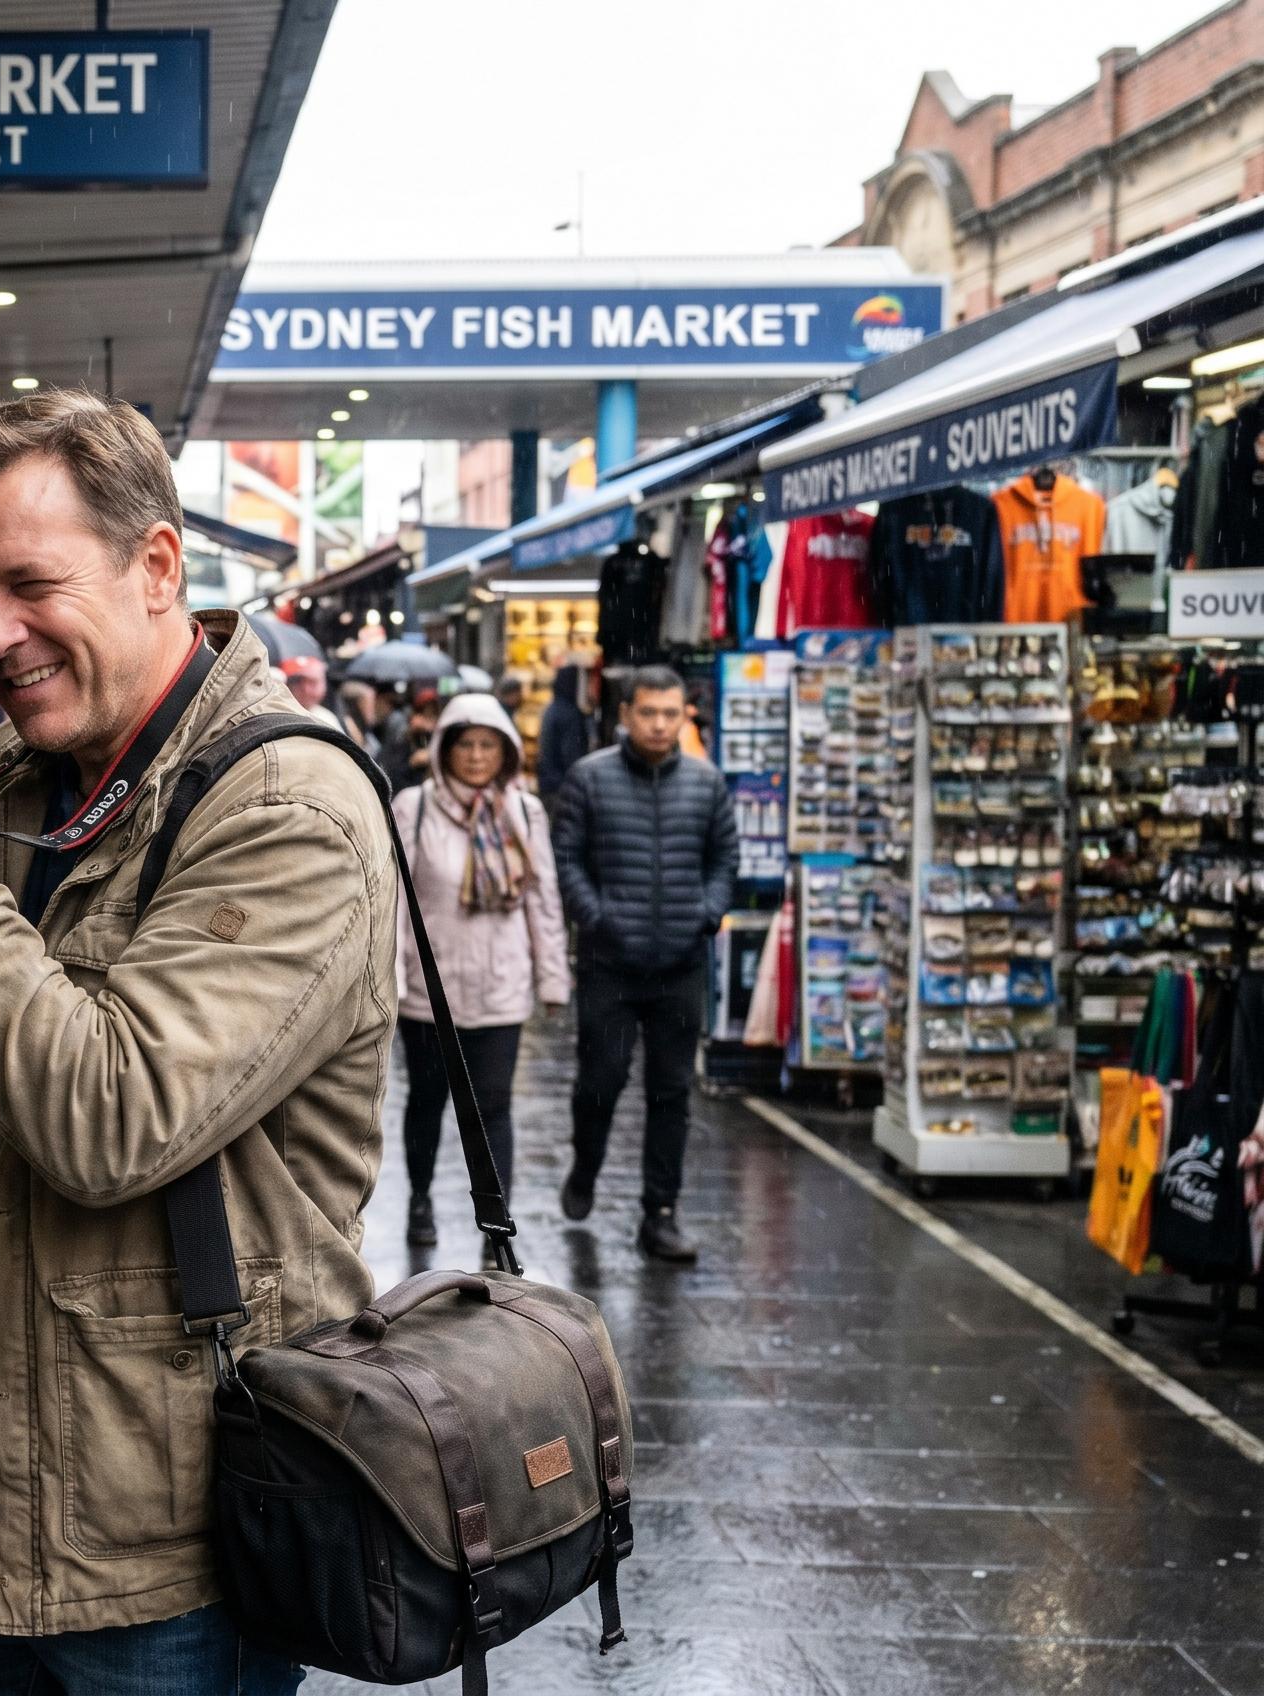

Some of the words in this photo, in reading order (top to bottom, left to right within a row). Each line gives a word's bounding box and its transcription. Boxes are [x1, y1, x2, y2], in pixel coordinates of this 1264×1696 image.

[220, 307, 437, 352] SYDNEY
[451, 306, 573, 349] FISH
[590, 303, 820, 349] MARKET
[846, 435, 922, 496] MARKET
[946, 387, 1076, 472] SOUVENITS
[1182, 592, 1264, 617] SOUV
